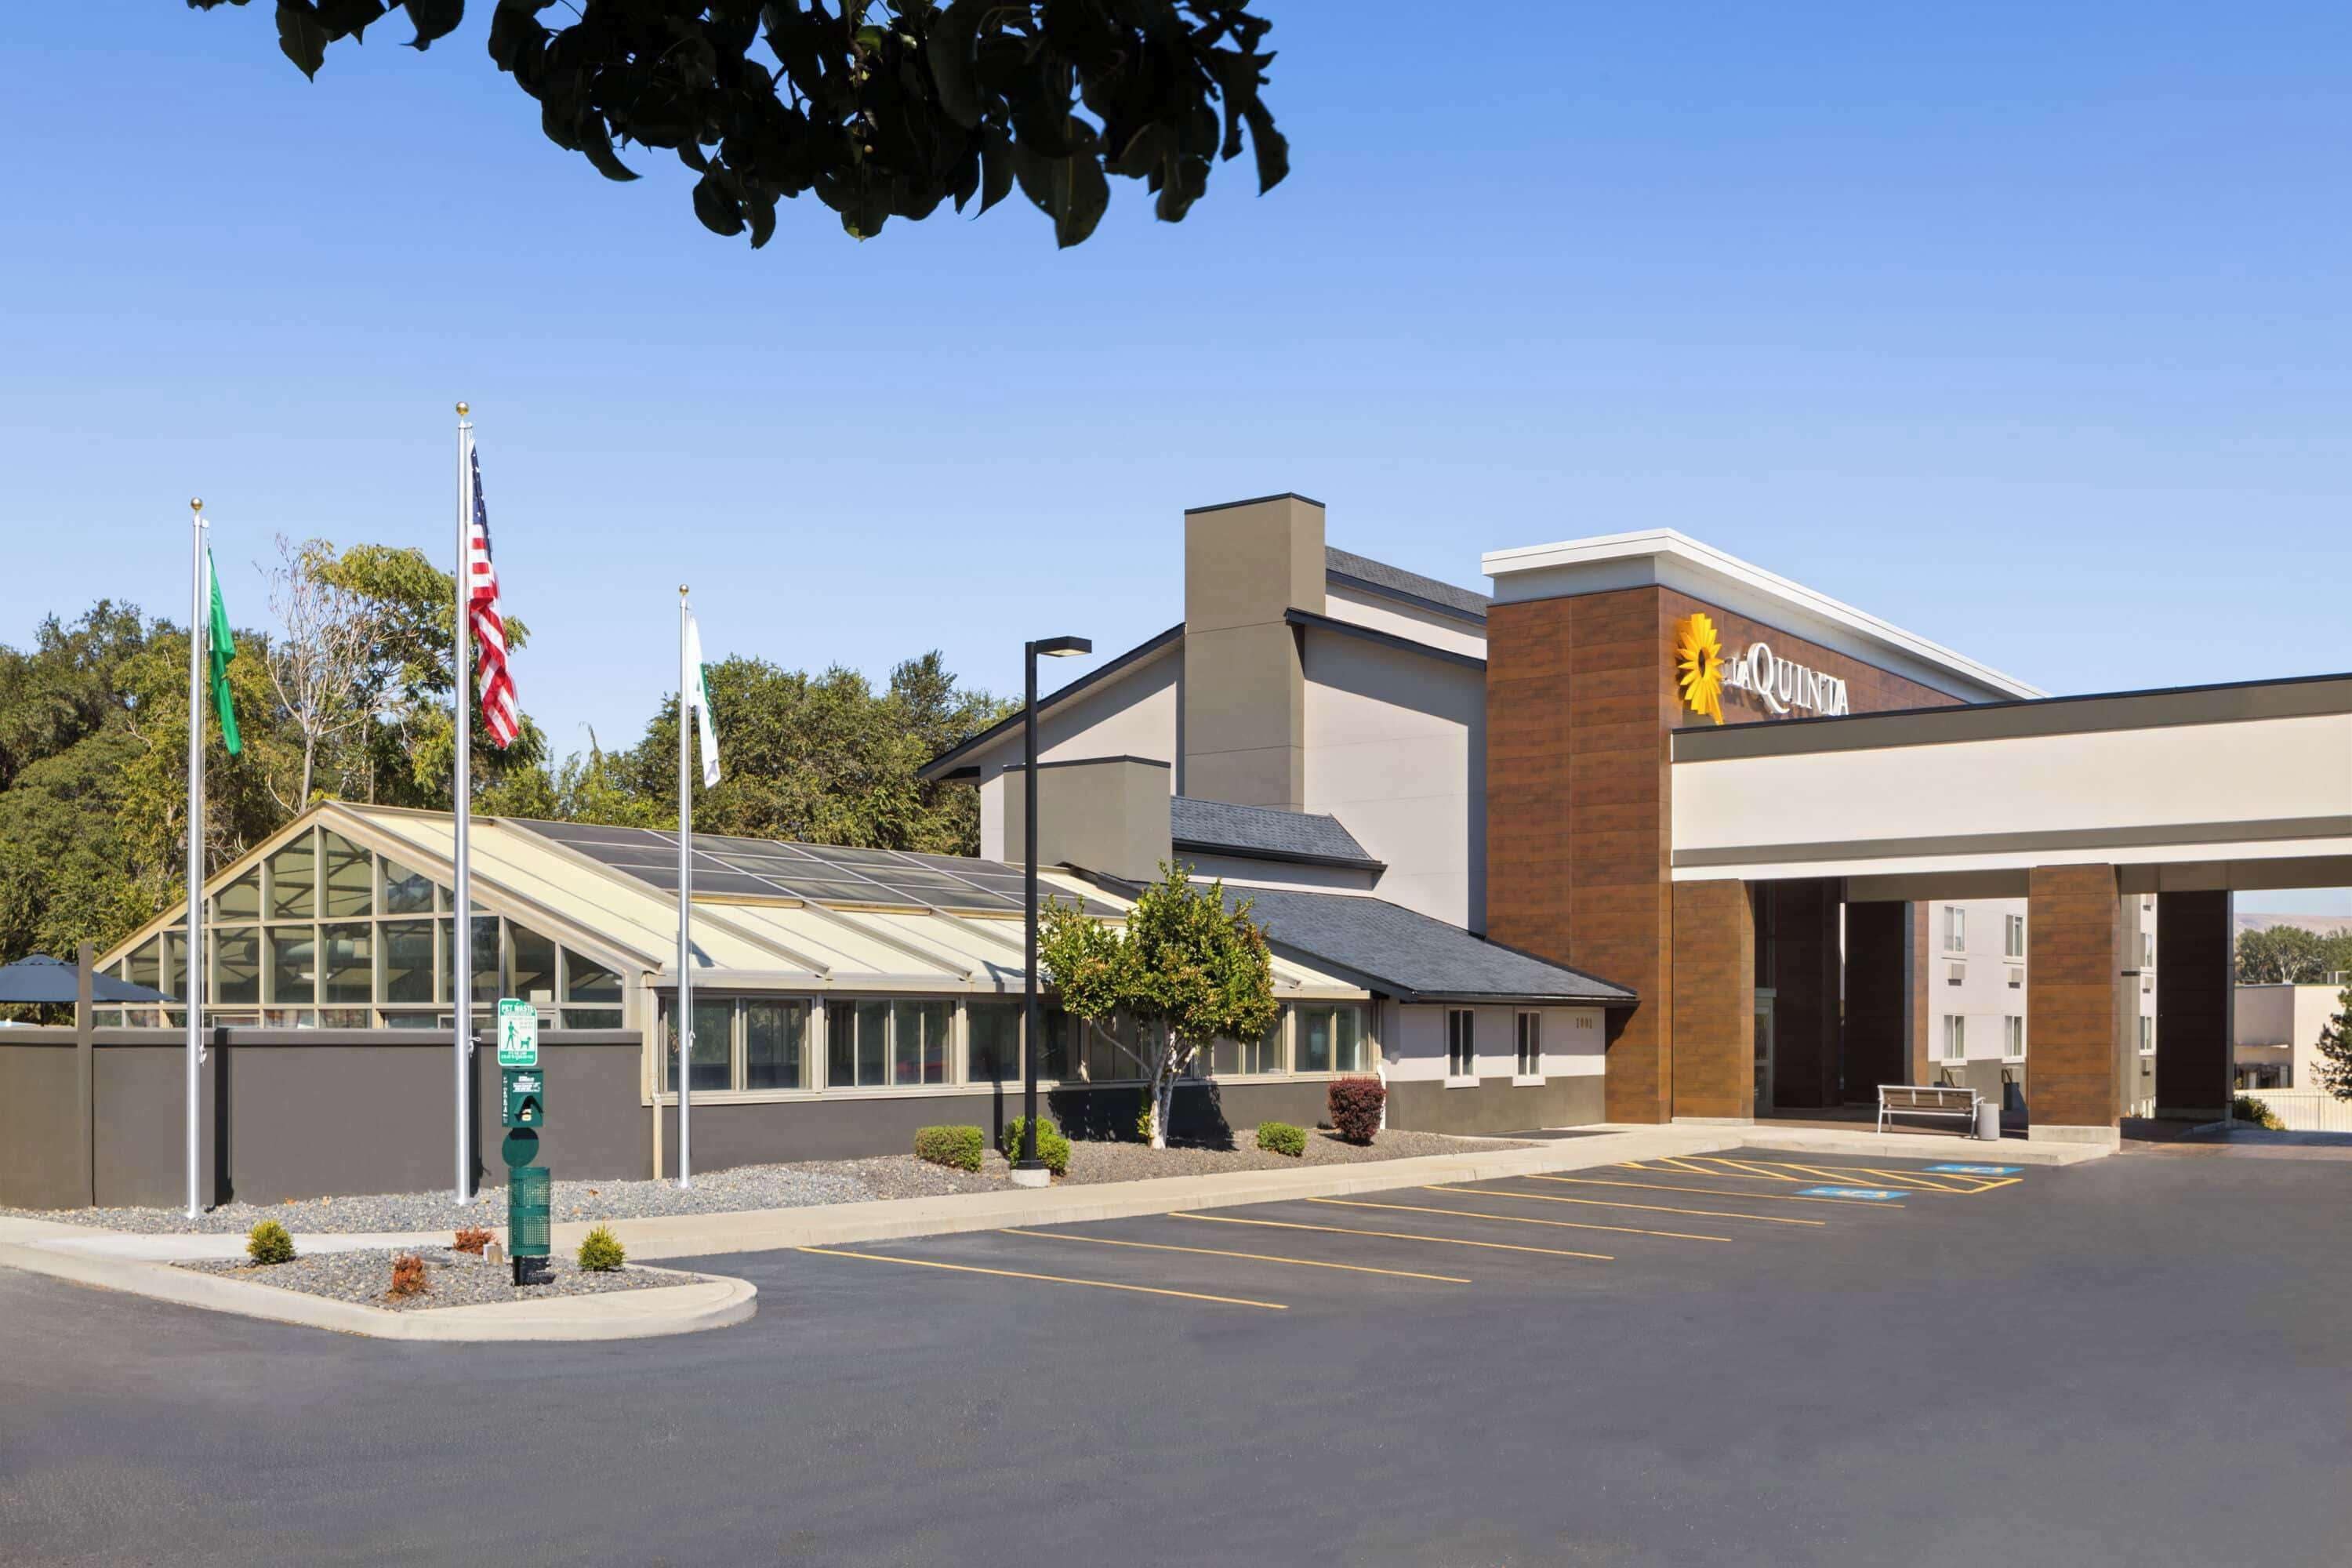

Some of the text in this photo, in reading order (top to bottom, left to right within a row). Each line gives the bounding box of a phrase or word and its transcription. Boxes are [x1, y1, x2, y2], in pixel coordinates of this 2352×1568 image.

[1721, 642, 1849, 715] LA QUINTA
[502, 1004, 514, 1012] PET
